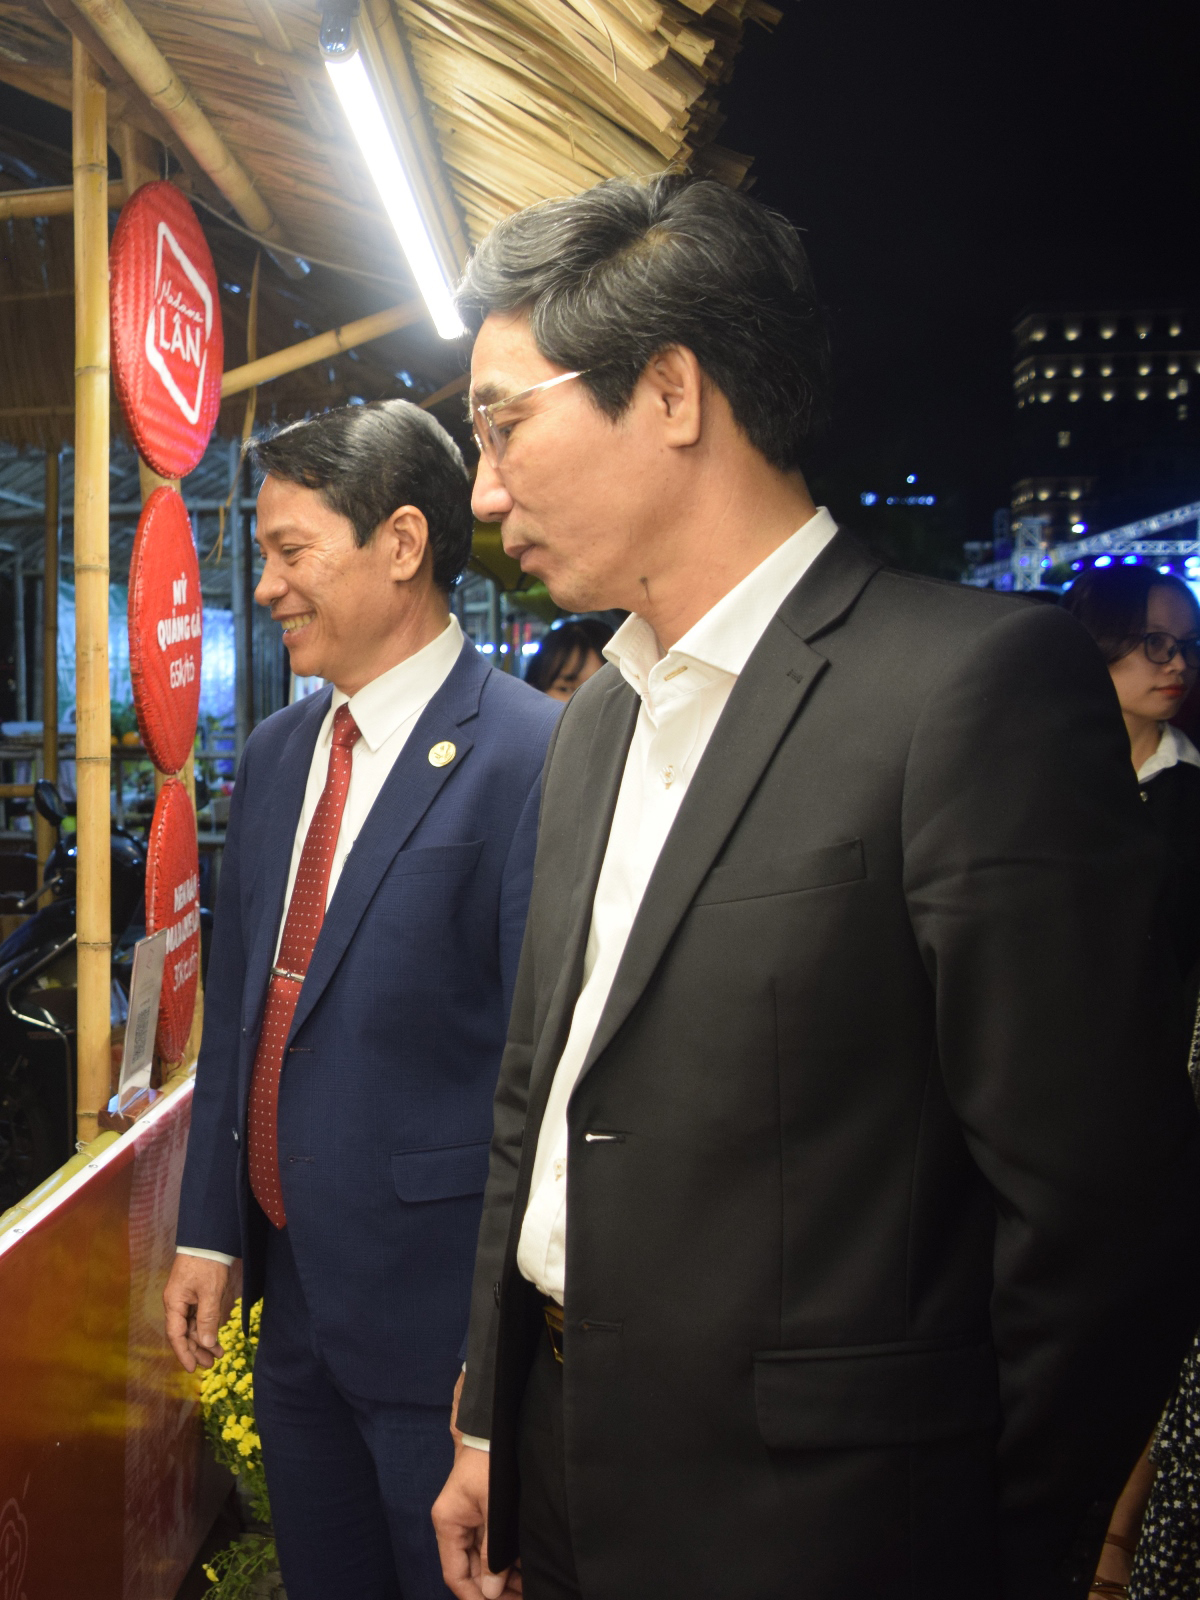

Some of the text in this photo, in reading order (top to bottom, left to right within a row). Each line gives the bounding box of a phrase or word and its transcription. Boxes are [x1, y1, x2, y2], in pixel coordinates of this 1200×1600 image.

[157, 280, 203, 323] Madame
[160, 306, 200, 368] LÂN
[157, 607, 191, 652] QUẢNG
